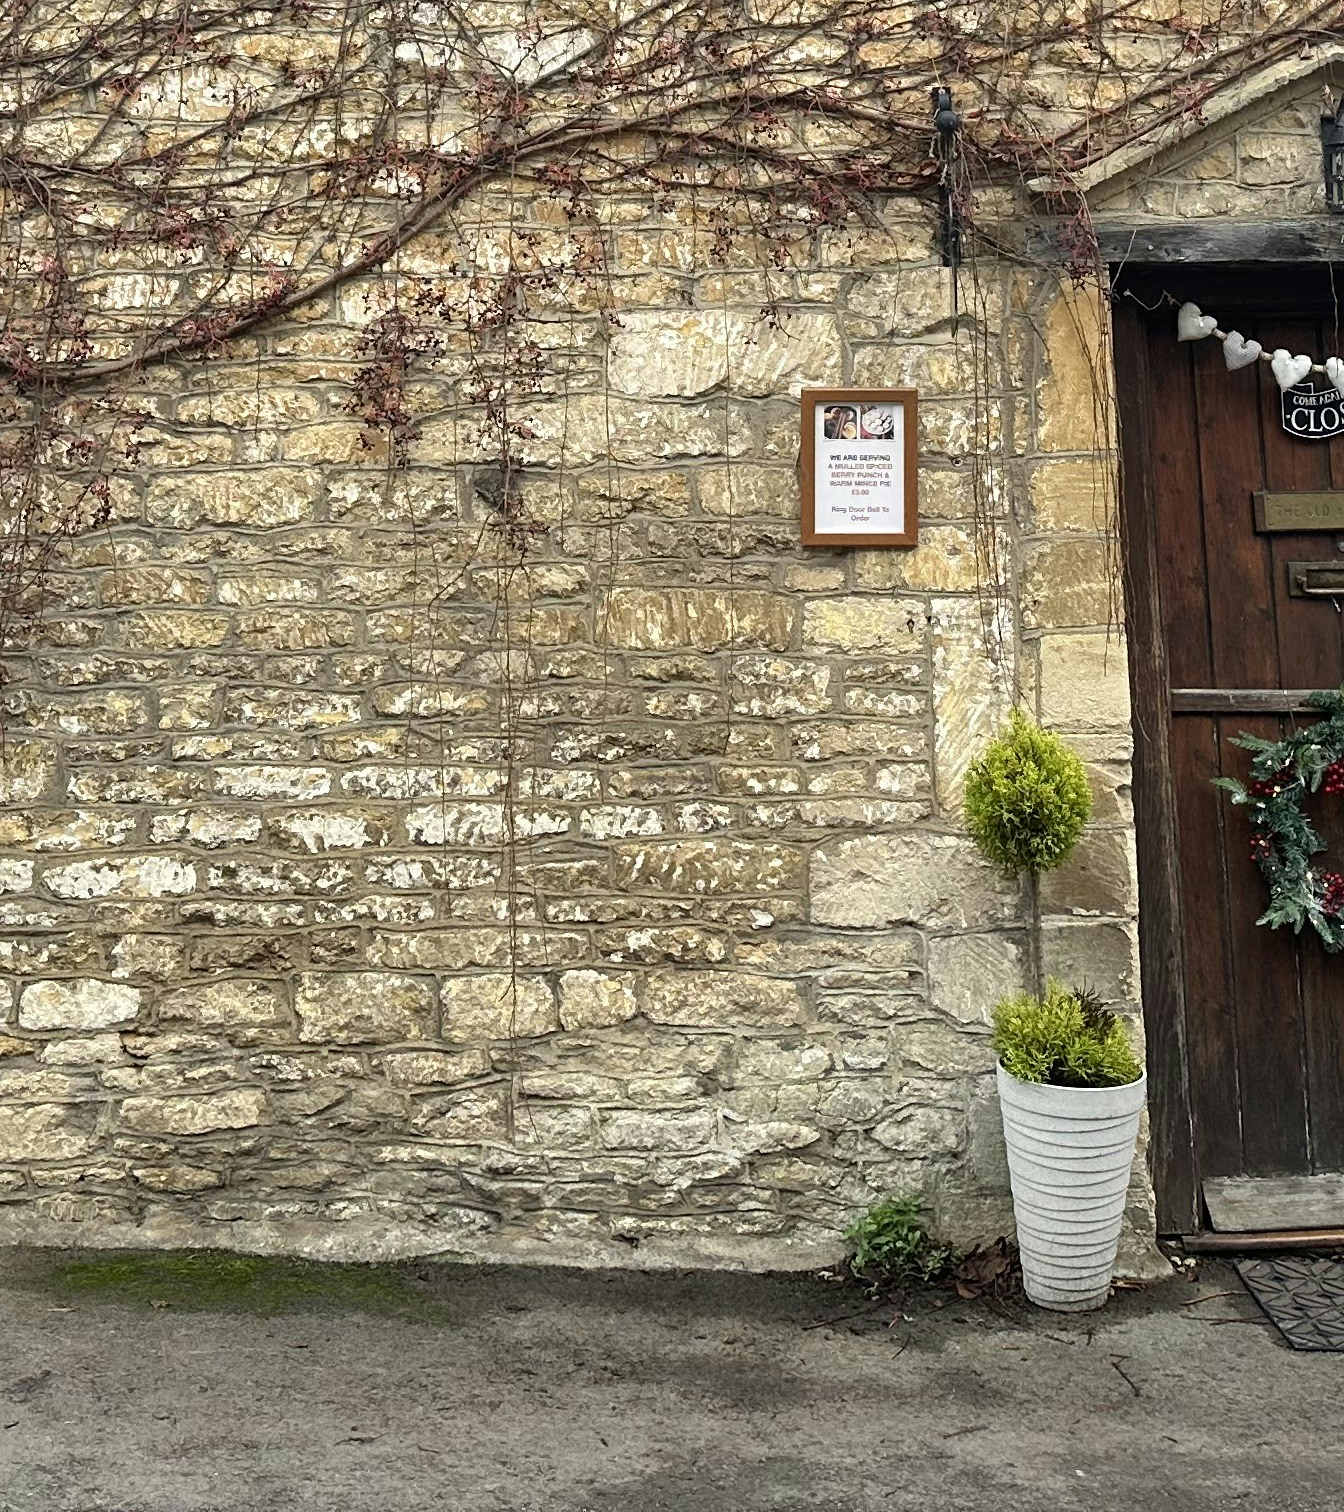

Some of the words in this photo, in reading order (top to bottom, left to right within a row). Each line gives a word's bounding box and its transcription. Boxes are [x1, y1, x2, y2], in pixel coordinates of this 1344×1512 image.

[1293, 395, 1318, 406] COME
[1275, 504, 1301, 518] THE
[1307, 503, 1330, 518] OLD
